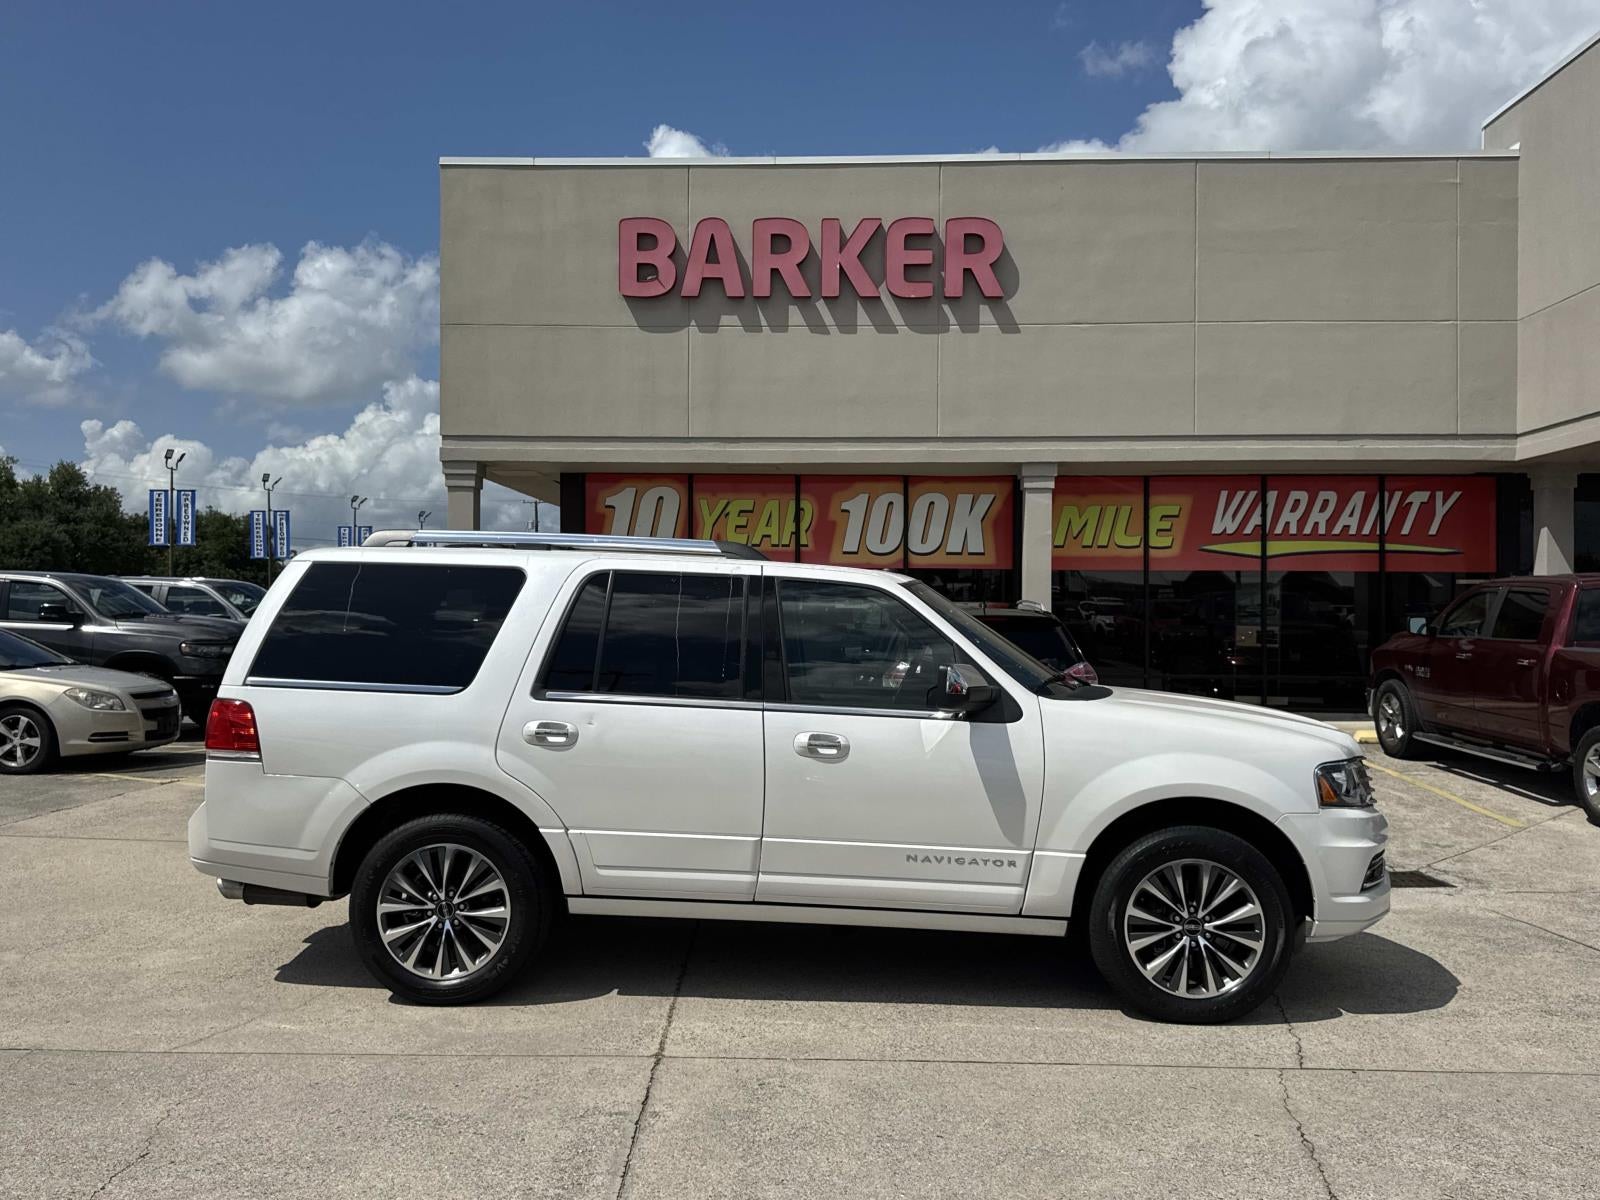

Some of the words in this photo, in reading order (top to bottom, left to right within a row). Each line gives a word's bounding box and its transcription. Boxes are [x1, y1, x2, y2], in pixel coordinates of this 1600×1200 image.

[618, 216, 1005, 298] BARKER
[604, 486, 681, 538] 10
[700, 499, 815, 548] YEAR
[840, 492, 997, 556] 100K
[1052, 504, 1182, 549] MILE
[1210, 489, 1463, 536] WARRANTY
[905, 854, 1018, 868] NAVIGATOR
